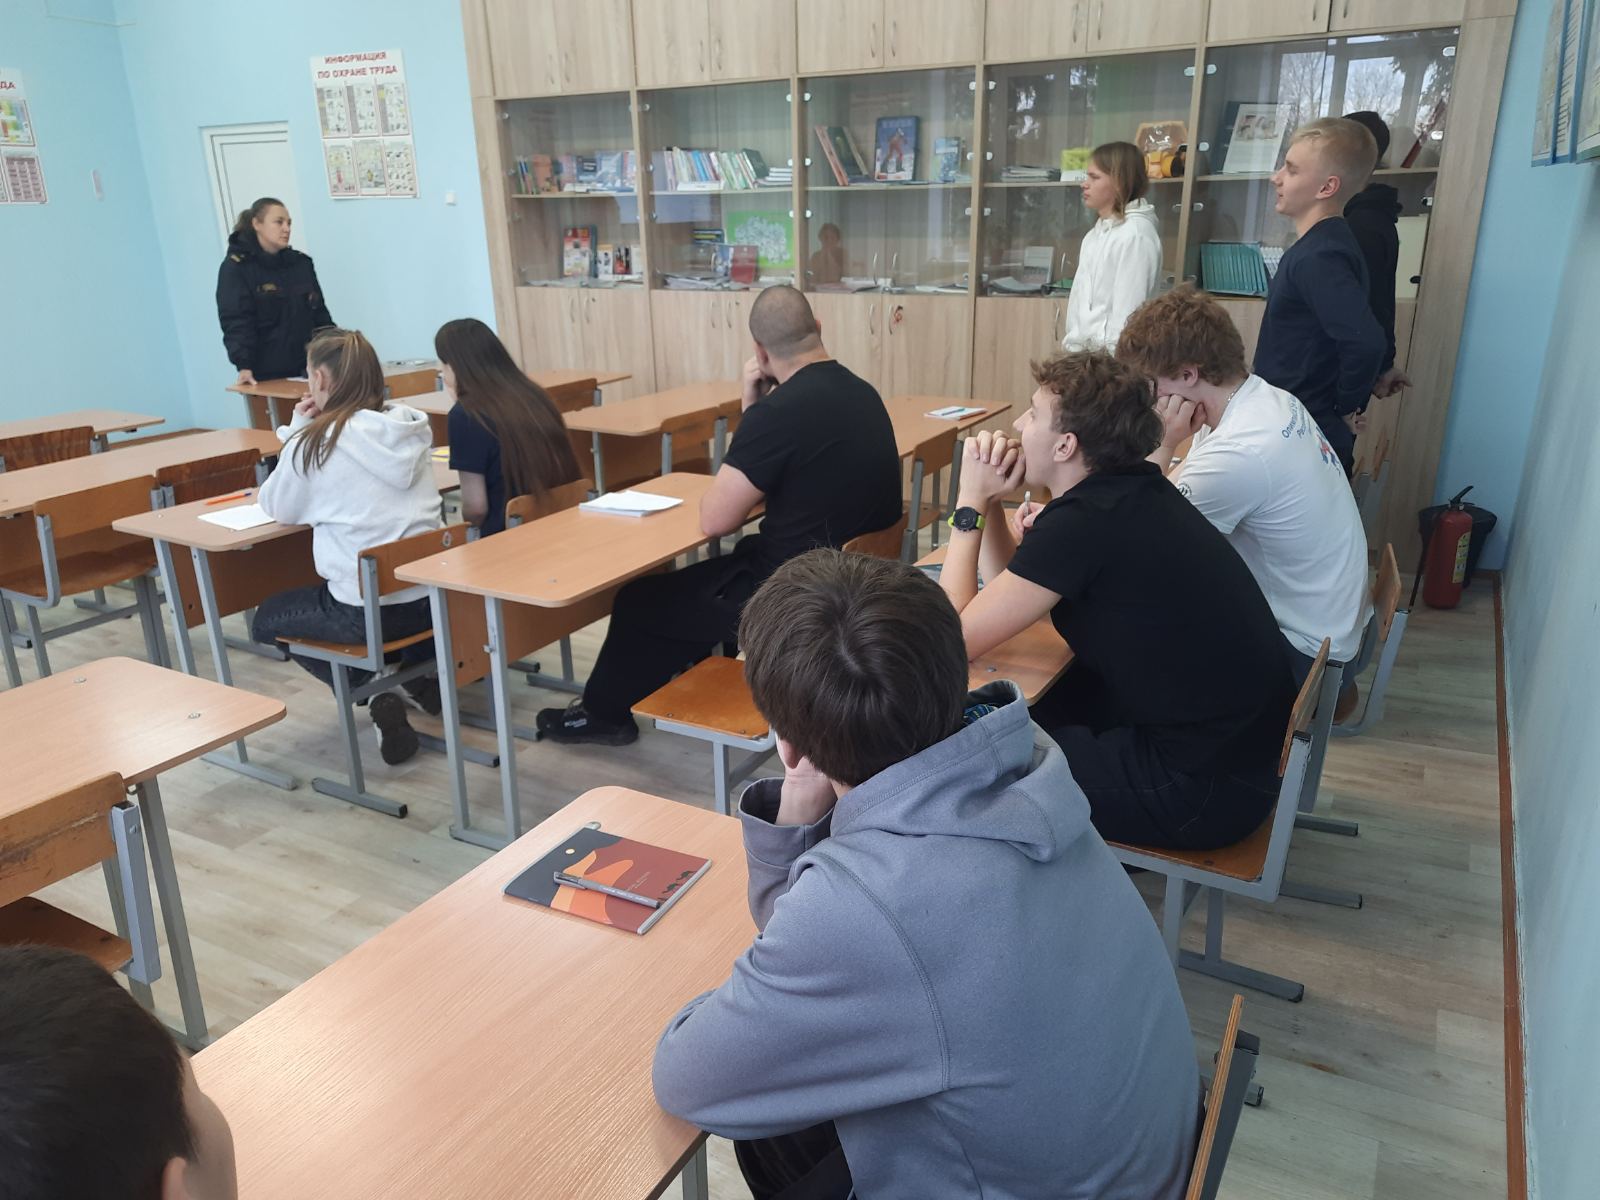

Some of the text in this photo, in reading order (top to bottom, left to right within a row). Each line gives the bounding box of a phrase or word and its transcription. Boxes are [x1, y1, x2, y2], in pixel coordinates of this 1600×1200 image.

[325, 52, 386, 64] ИНФОРМАЦИЯ
[317, 65, 397, 79] ПО ОХРАНЕ ТРУДА
